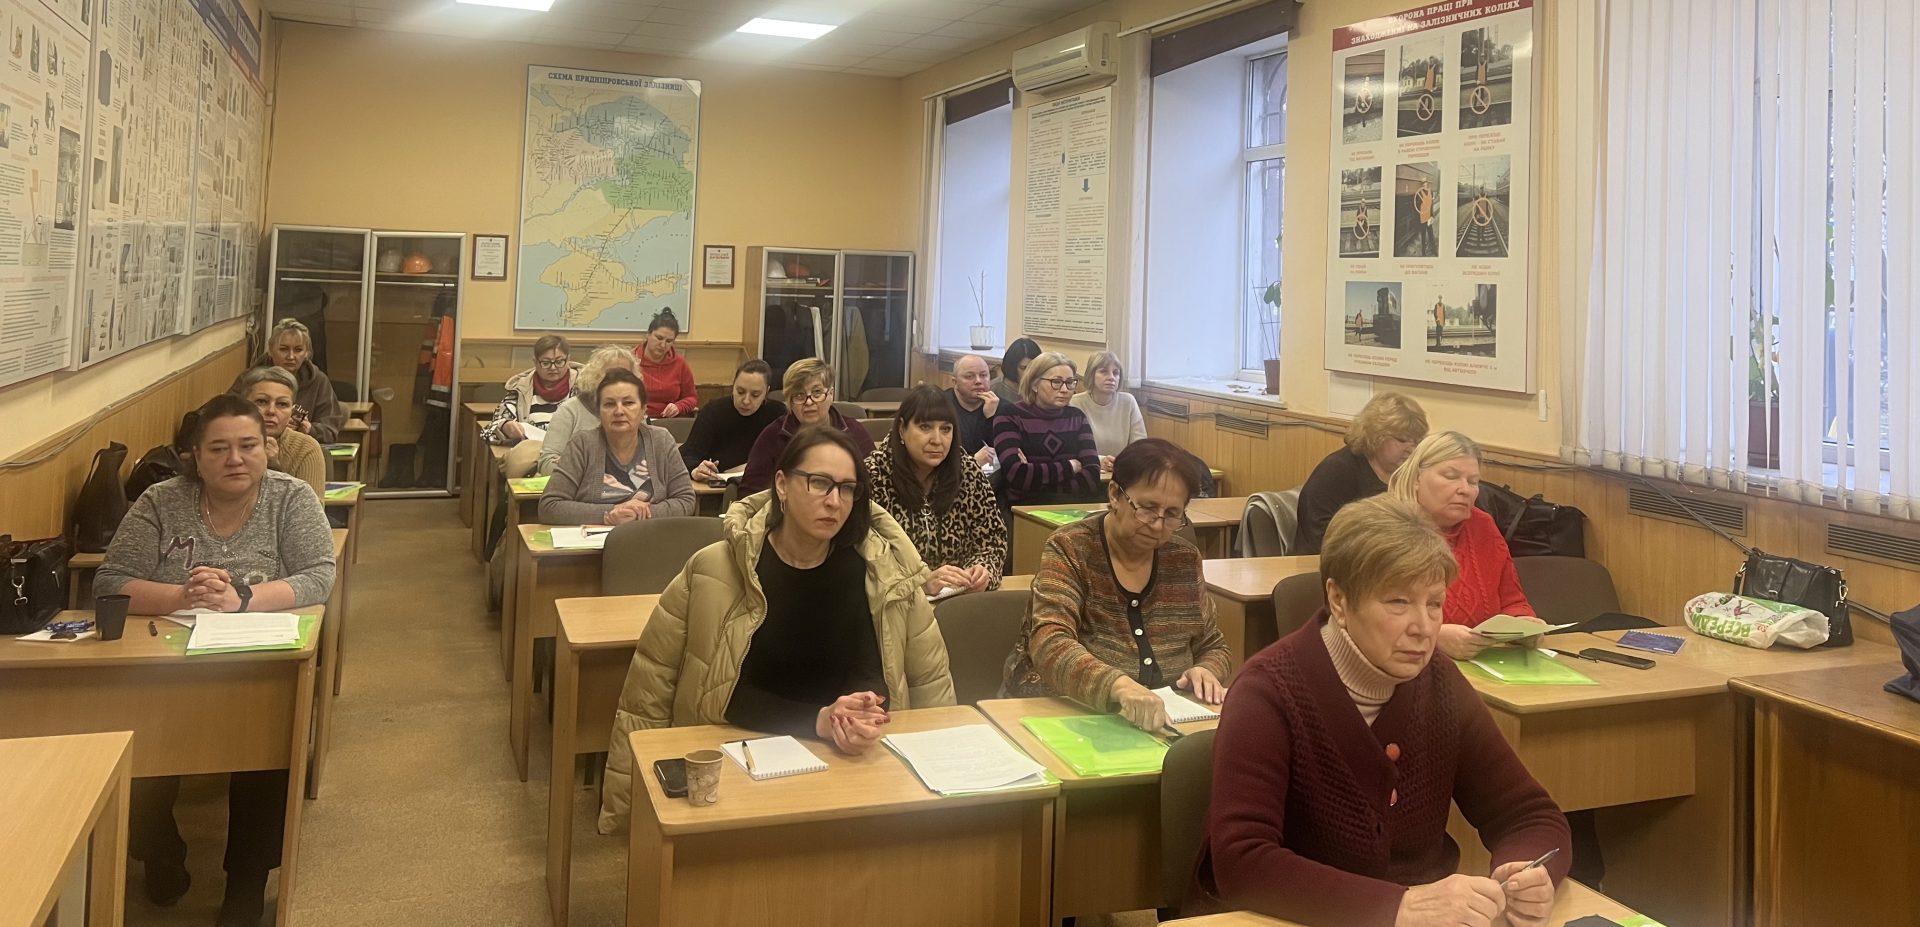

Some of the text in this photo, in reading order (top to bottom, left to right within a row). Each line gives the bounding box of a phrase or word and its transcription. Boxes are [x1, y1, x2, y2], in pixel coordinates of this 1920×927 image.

[1407, 22, 1419, 31] НА
[1420, 8, 1482, 28] ЗАЛІЗНИЧНИХ
[1485, 0, 1520, 14] КОЛІЯХ
[1426, 2, 1453, 15] ПРАЦІ
[548, 72, 573, 82] СХЕМА
[575, 74, 642, 88] ПРИДНІПРОВСЬКОЇ
